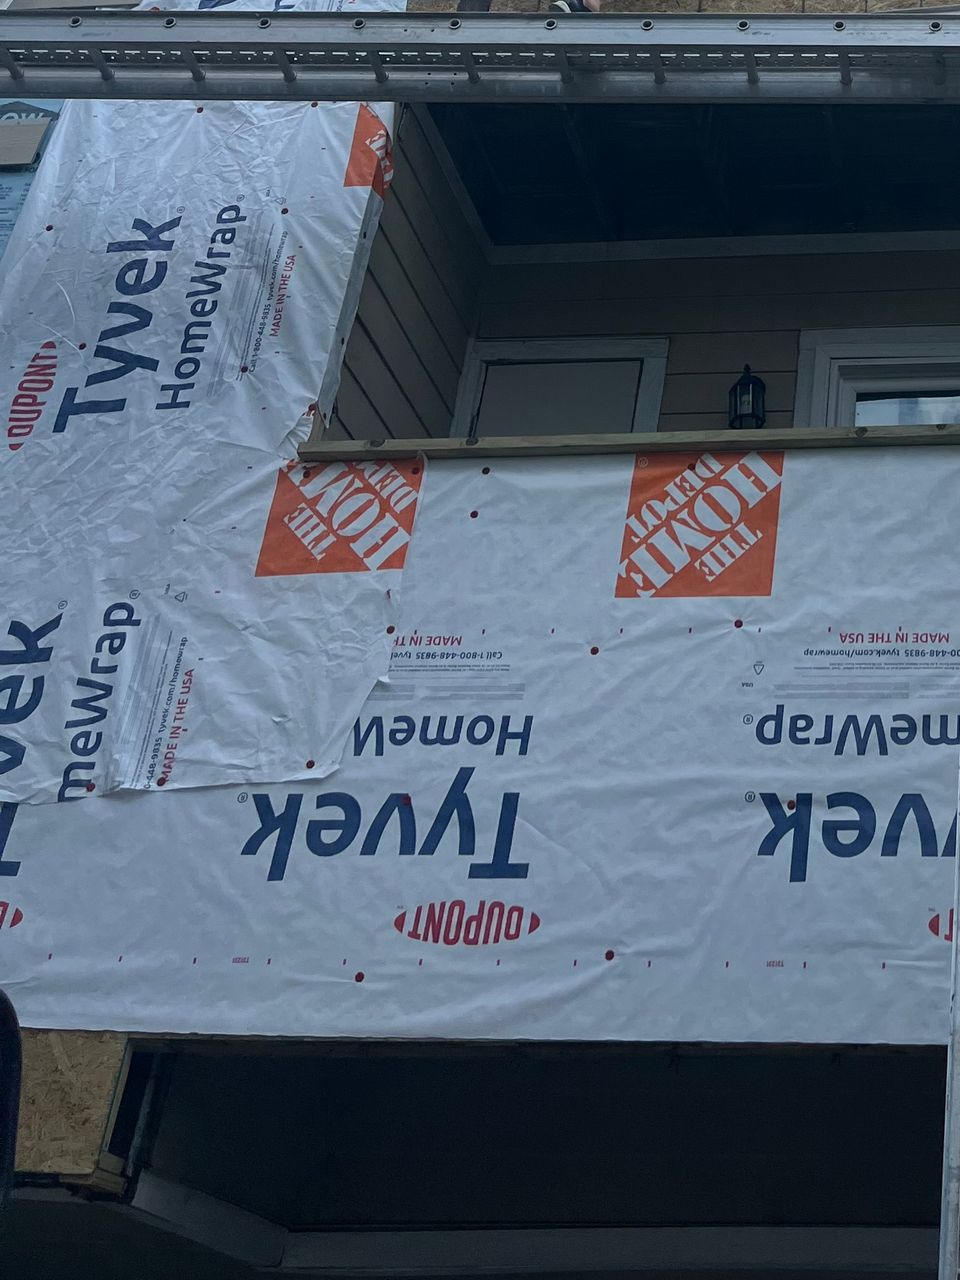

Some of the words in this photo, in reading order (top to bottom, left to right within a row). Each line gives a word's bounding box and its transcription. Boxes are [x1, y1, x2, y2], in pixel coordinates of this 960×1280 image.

[285, 255, 297, 272] USA
[280, 274, 291, 292] THE
[155, 205, 247, 410] HomeWrap
[276, 293, 285, 306] IN
[52, 216, 182, 433] Tyvek
[253, 304, 271, 358] 1-800-448-9835
[270, 307, 283, 337] MADE
[8, 352, 57, 437] DUPONT
[625, 452, 725, 543] DEPOT
[283, 503, 336, 561] THE
[618, 452, 782, 597] HOME
[694, 522, 763, 582] THE
[409, 636, 423, 646] IN
[425, 636, 462, 646] MADE
[839, 632, 864, 644] USA
[868, 632, 892, 644] THE
[895, 632, 908, 644] IN
[912, 632, 950, 644] MADE
[416, 651, 484, 660] 1-800-448-9835
[486, 651, 503, 660] Call
[803, 648, 900, 659] tyvek.com/homewrap
[159, 637, 188, 733] tyvek.com/homewrap
[181, 669, 194, 695] USA
[57, 602, 141, 802] meWrap
[173, 698, 188, 722] THE
[170, 726, 181, 740] IN
[353, 715, 534, 757] HomeW
[163, 743, 177, 782] MADE
[240, 767, 530, 881] Tyvek
[407, 899, 525, 946] DUPONT
